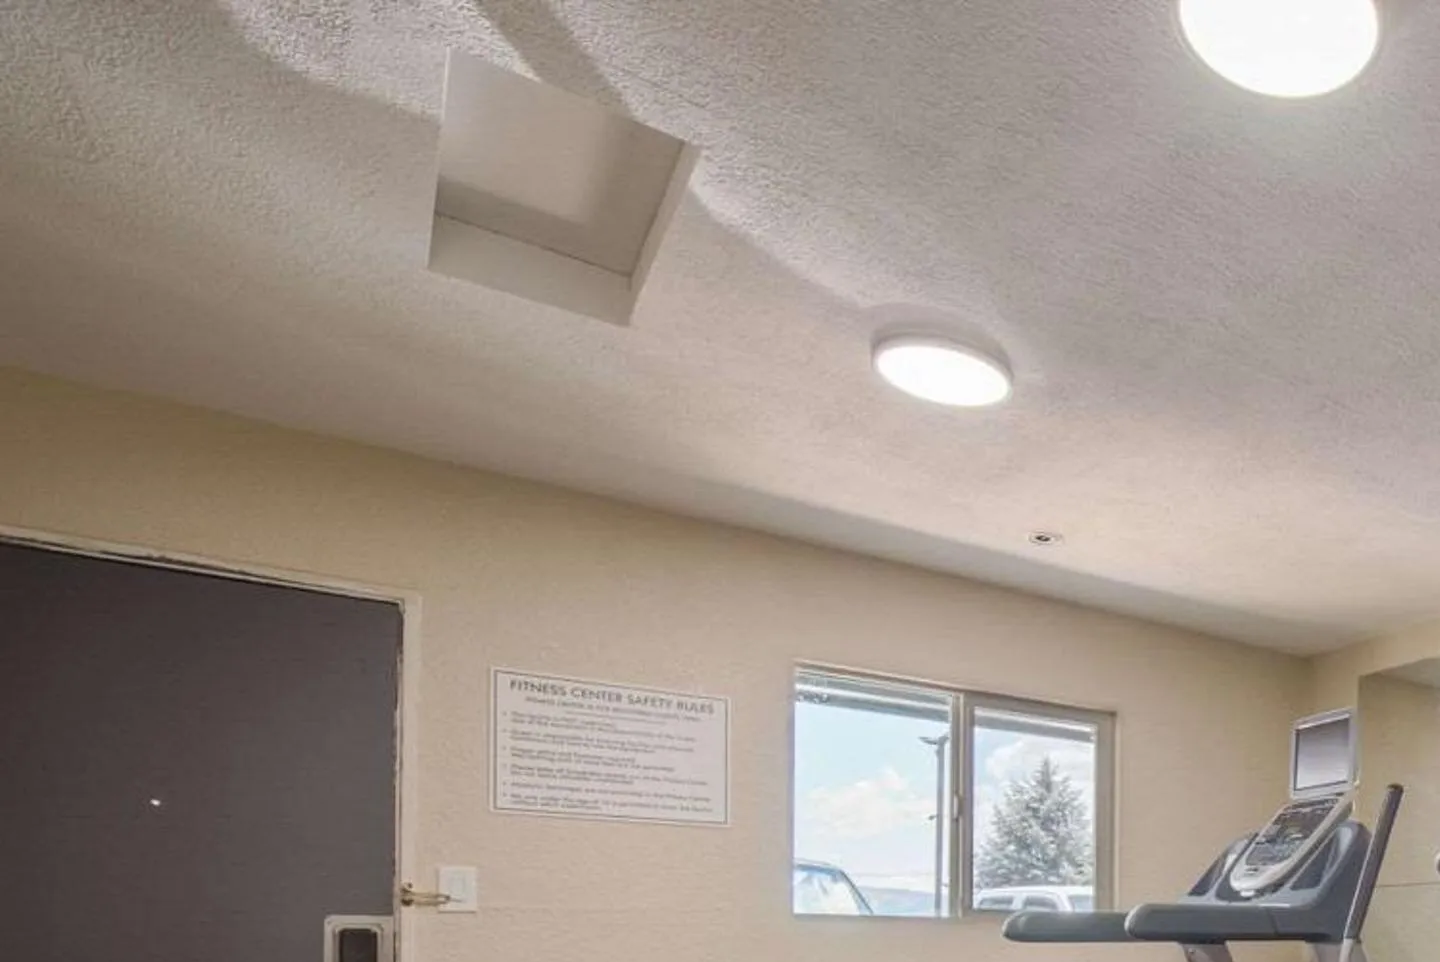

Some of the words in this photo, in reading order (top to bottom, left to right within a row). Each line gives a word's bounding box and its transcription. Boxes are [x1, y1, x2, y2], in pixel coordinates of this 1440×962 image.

[509, 680, 567, 696] FITNESS
[571, 687, 622, 702] CENTER
[627, 693, 672, 708] SAFETY
[676, 700, 715, 714] RULES
